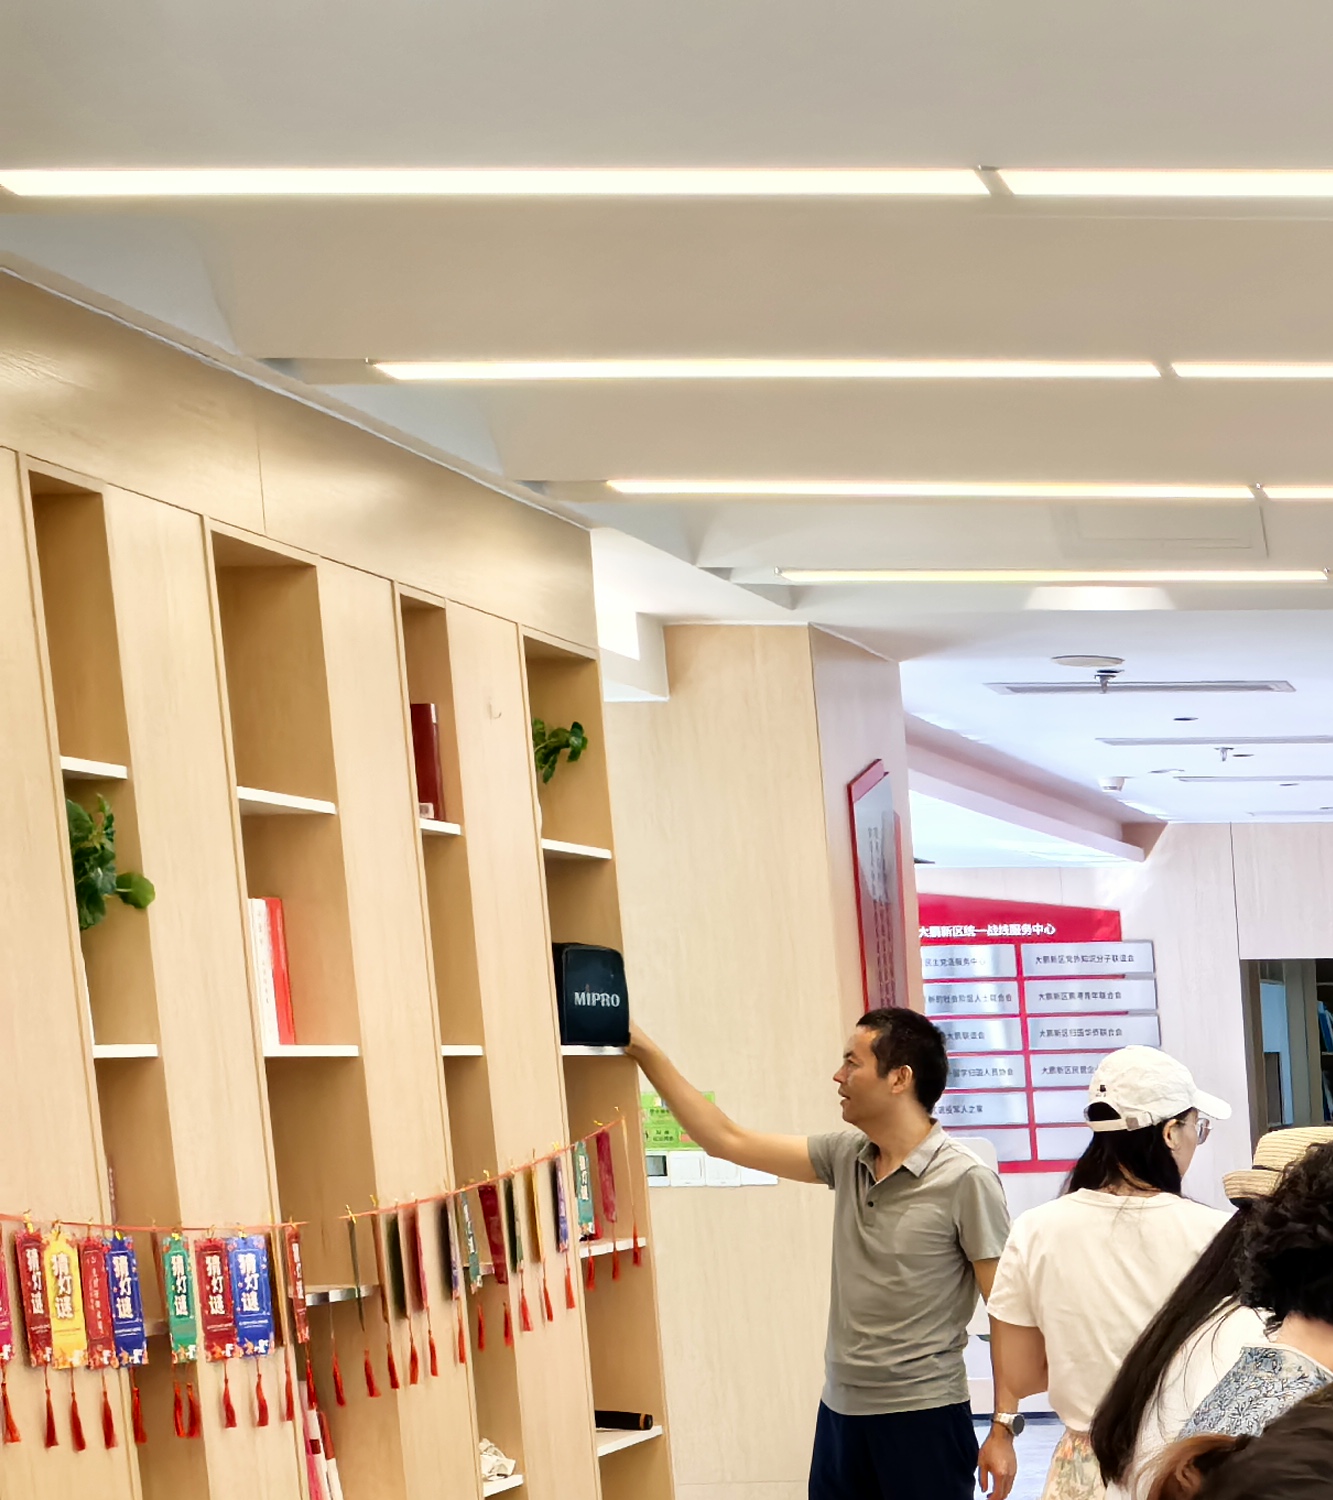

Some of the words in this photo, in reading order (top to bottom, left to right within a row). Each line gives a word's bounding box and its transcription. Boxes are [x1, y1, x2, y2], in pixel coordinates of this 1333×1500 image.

[574, 991, 621, 1008] MIPRO
[51, 1252, 74, 1319] 猜灯谜
[112, 1255, 134, 1318] 猜灯谜
[171, 1254, 188, 1316] 猜灯谜
[205, 1254, 226, 1315] 猜灯谜
[237, 1253, 260, 1311] 猜灯谜
